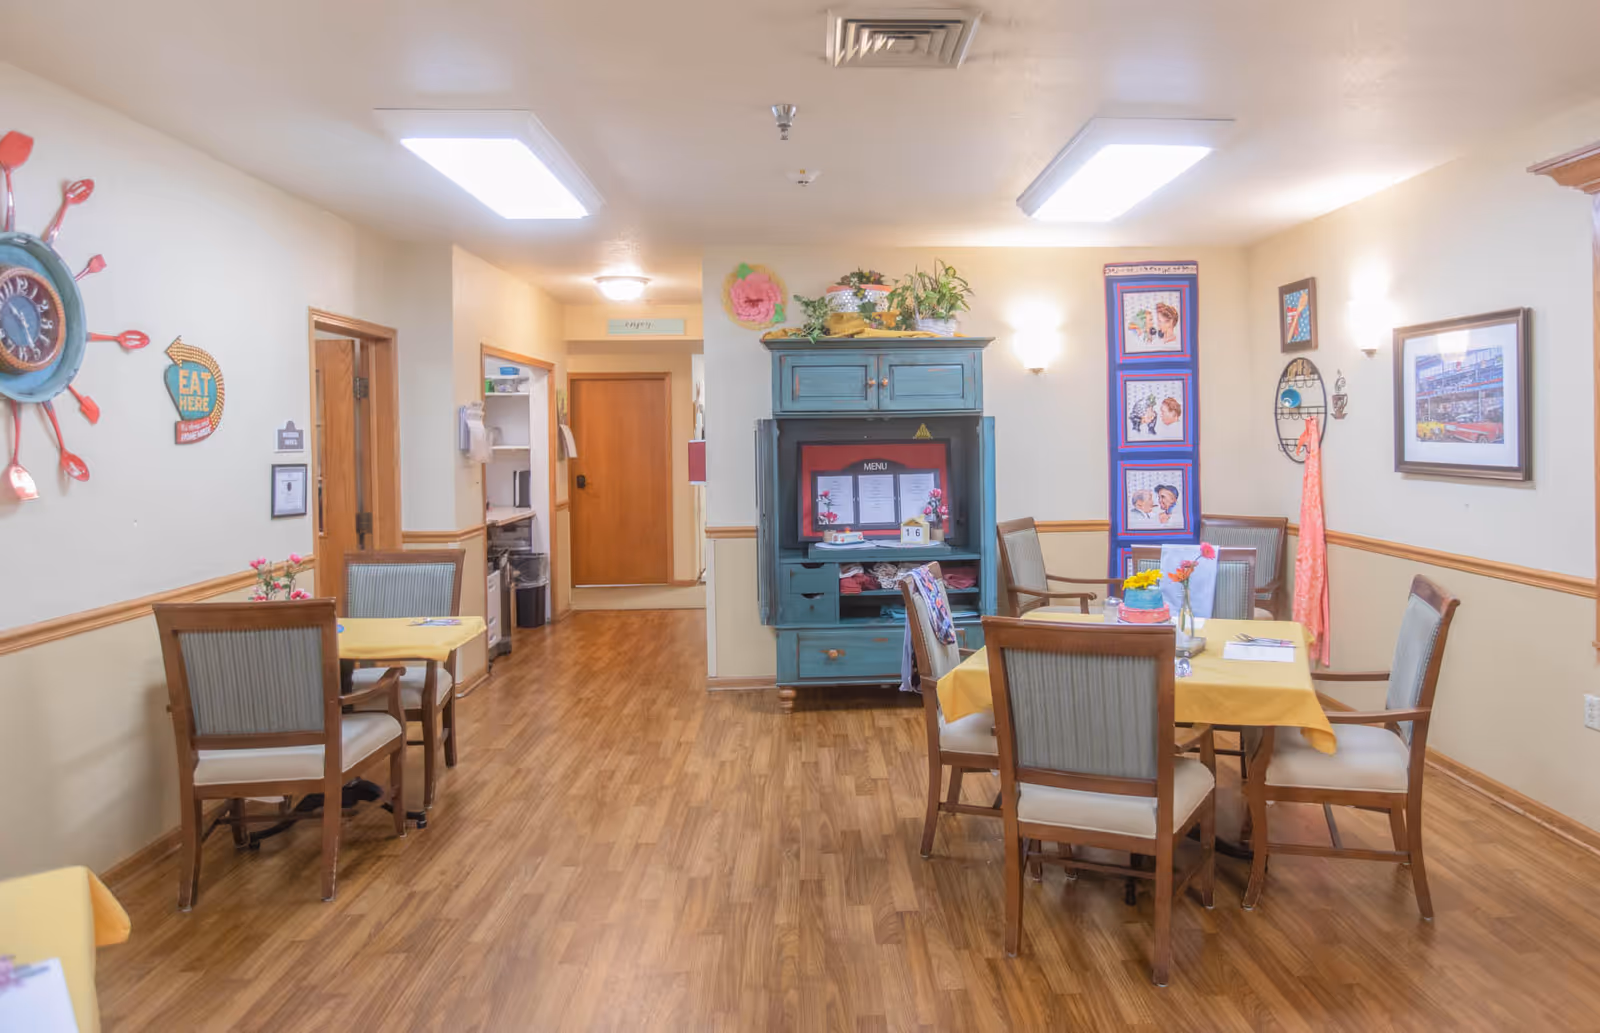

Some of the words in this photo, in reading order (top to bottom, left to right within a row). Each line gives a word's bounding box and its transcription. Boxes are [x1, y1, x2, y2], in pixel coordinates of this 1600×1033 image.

[179, 369, 211, 396] EAT
[179, 395, 210, 412] HERE
[863, 462, 888, 471] MENU
